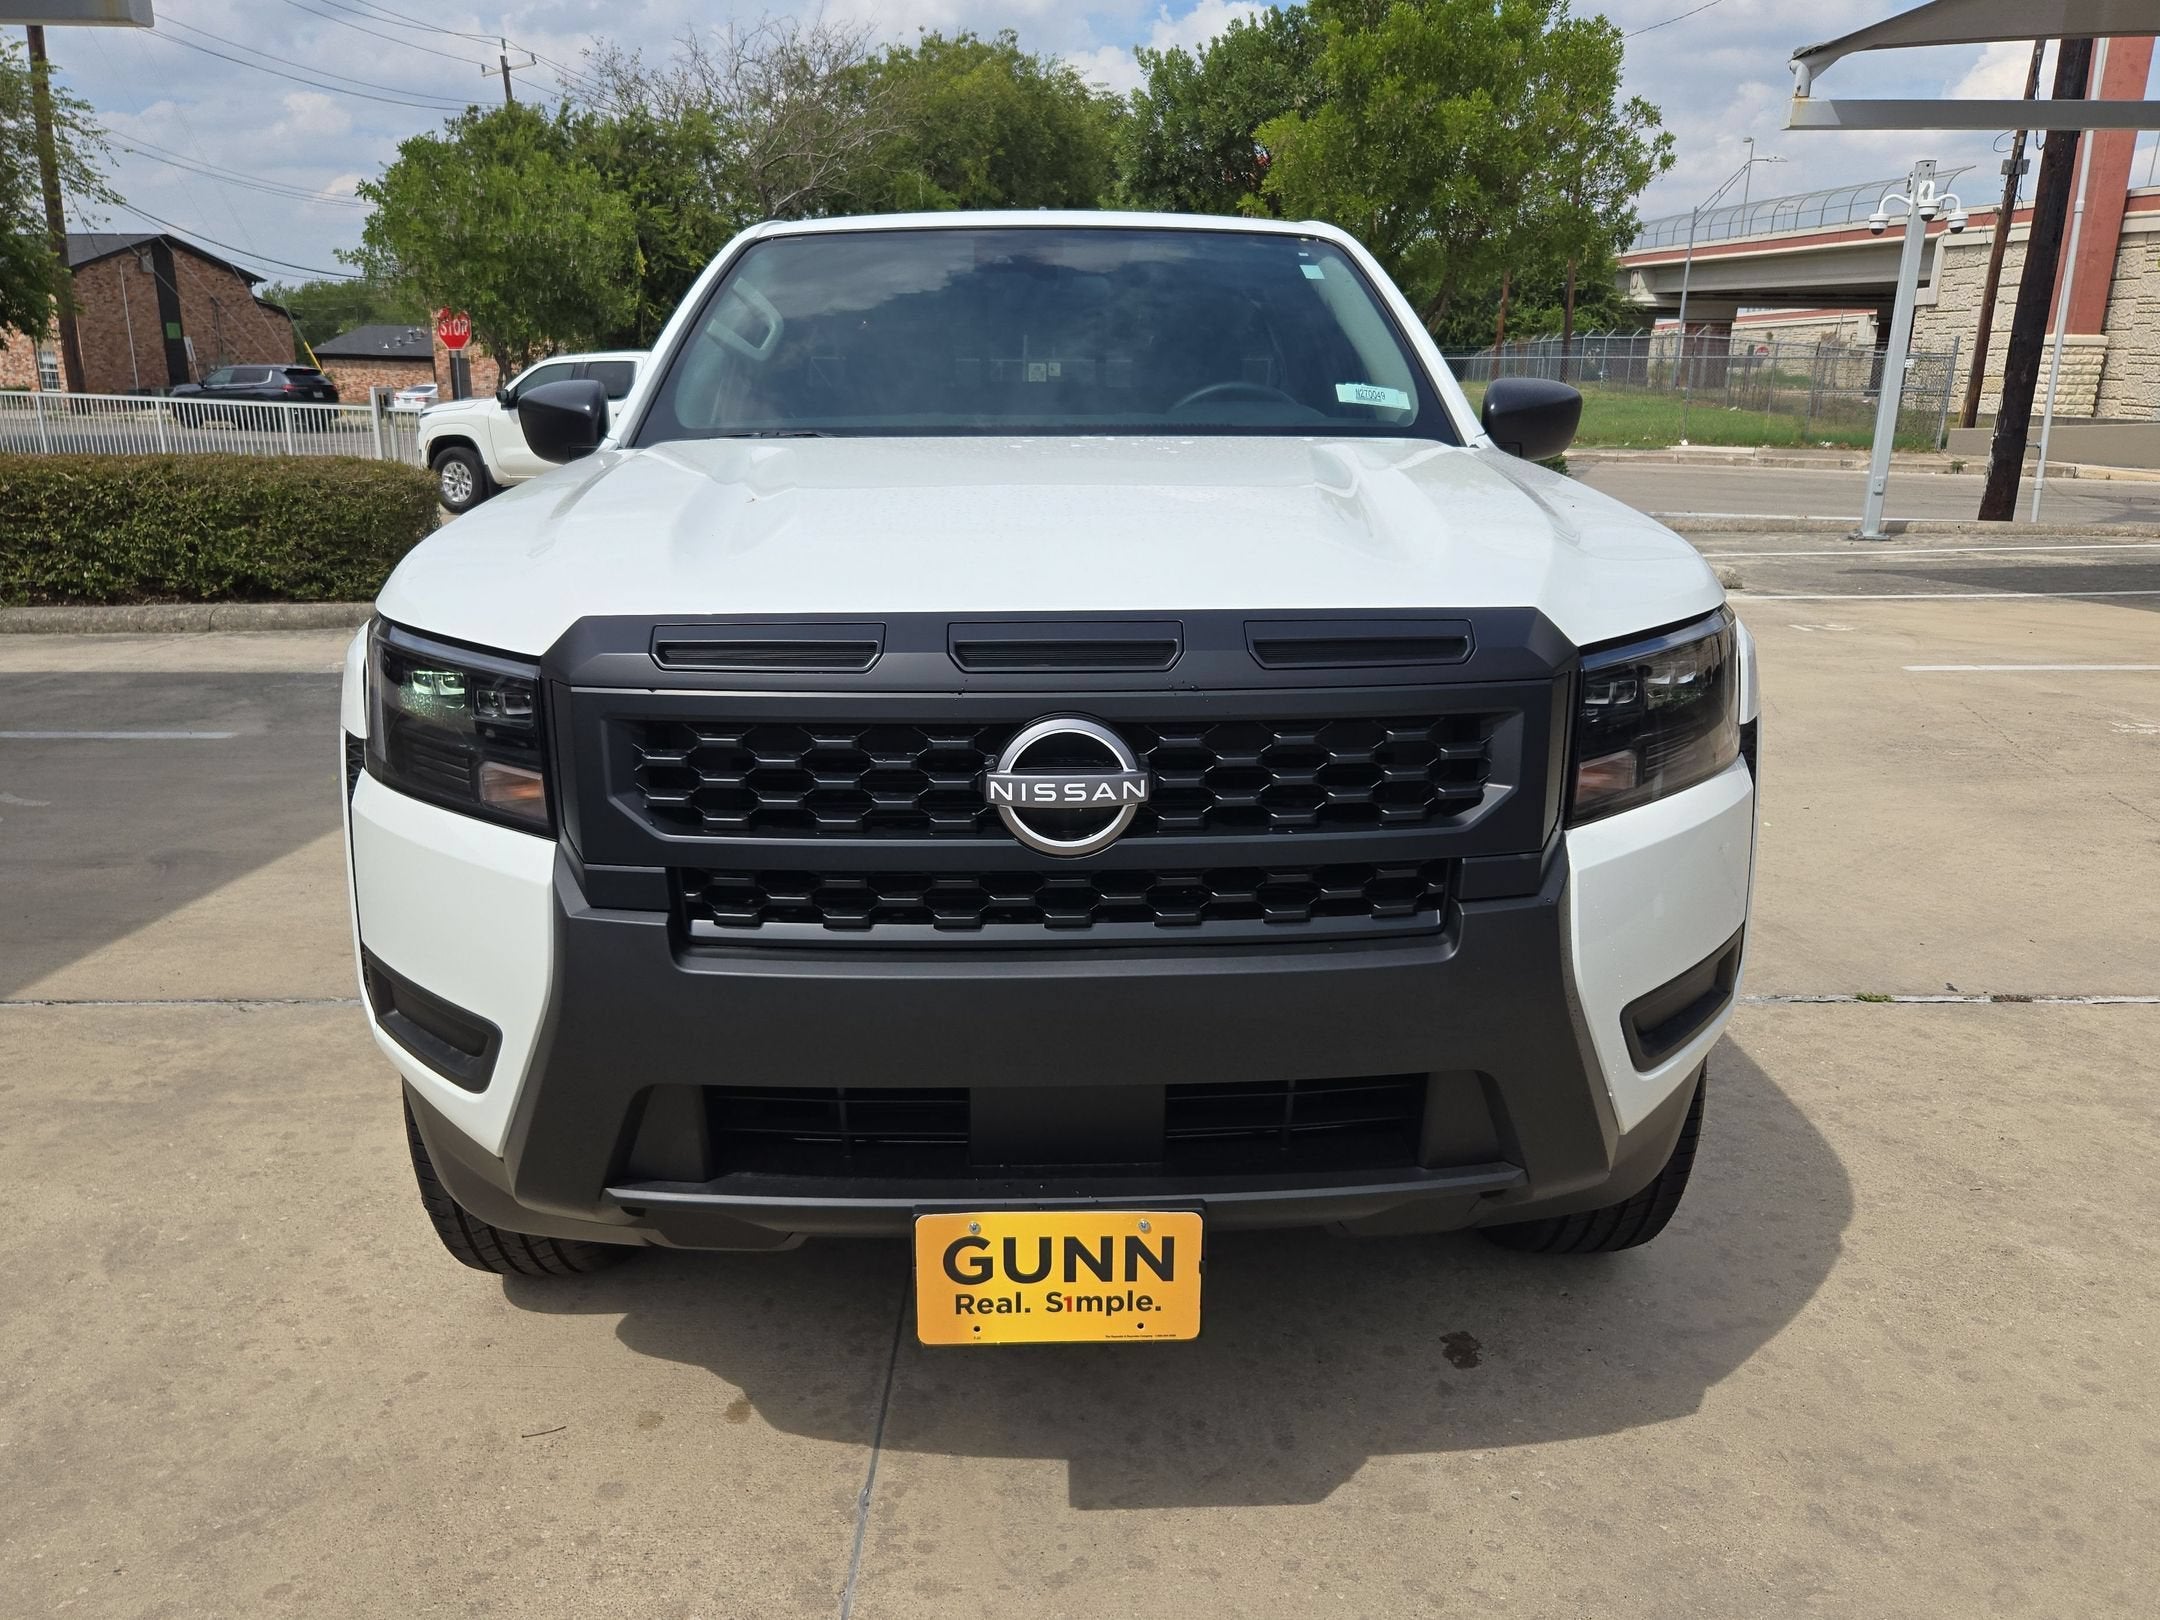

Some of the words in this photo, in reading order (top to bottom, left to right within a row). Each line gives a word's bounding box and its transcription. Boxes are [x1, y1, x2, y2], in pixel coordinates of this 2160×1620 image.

[440, 319, 469, 336] STOP
[990, 780, 1145, 802] NISSAN
[943, 1235, 1175, 1285] GUNN
[955, 1292, 1031, 1315] Real.
[1045, 1290, 1162, 1316] S1mple.
